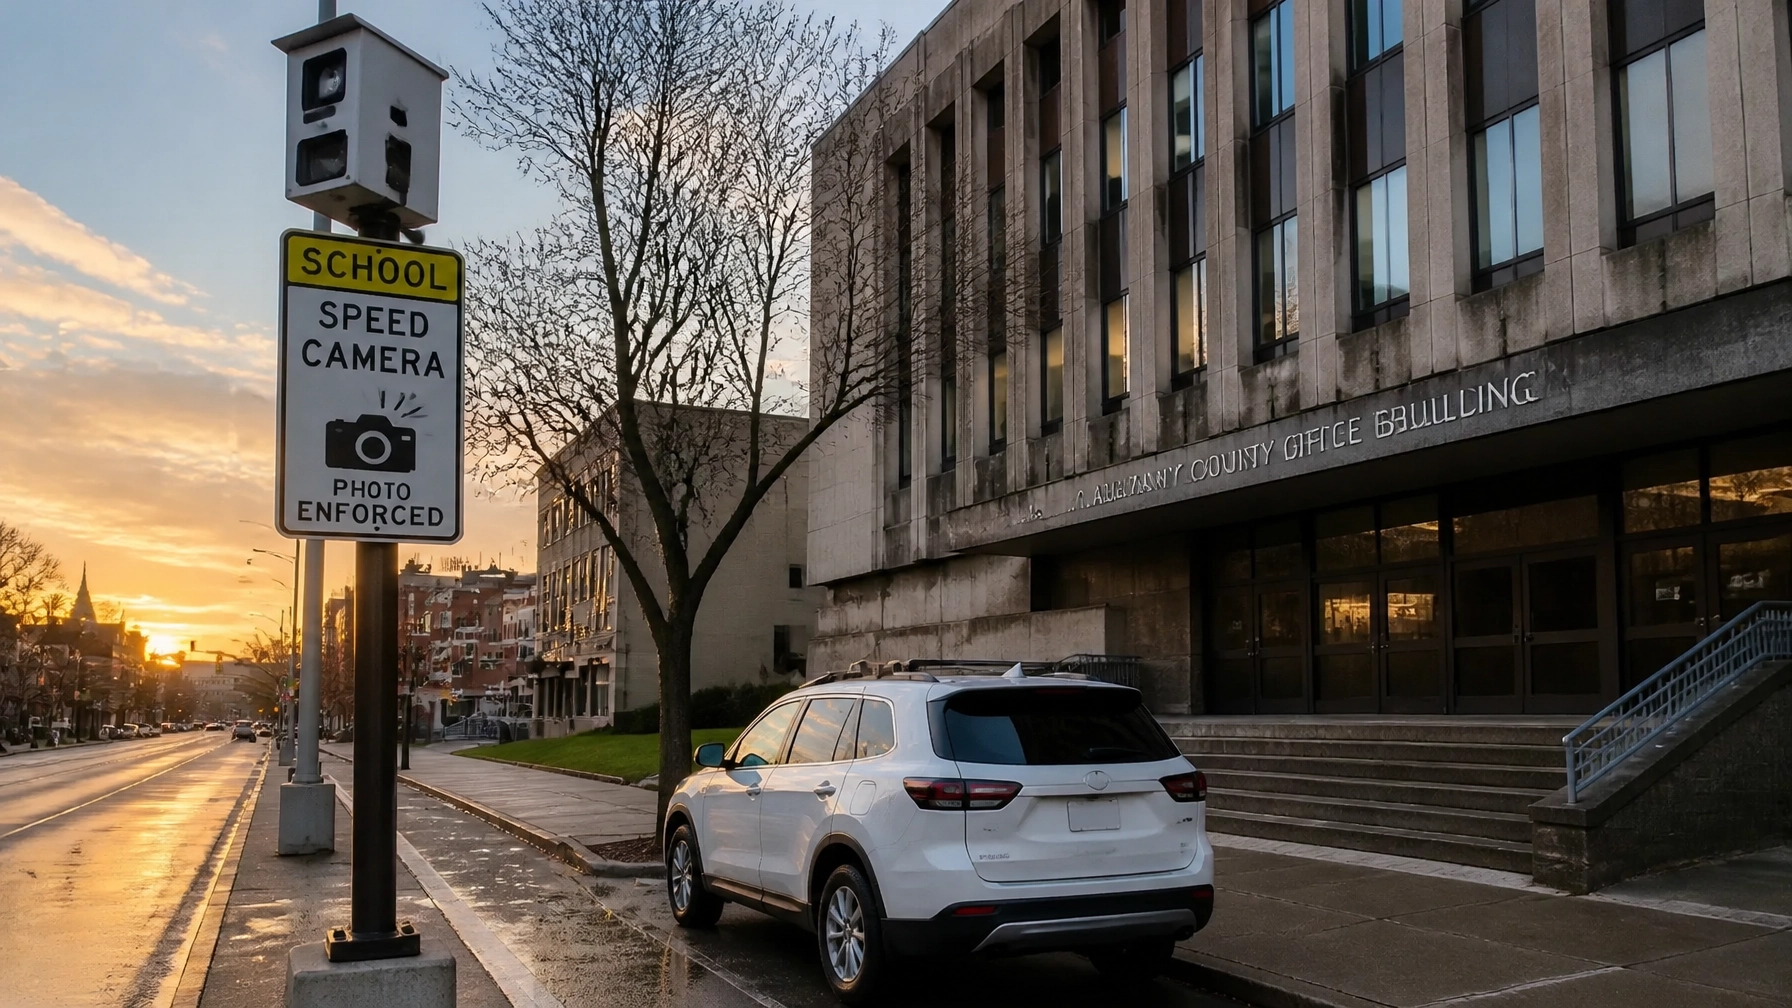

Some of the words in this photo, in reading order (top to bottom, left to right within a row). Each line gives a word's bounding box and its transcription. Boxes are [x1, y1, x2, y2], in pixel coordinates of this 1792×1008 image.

[301, 247, 447, 291] SCHOOL
[319, 301, 429, 338] SPEED
[302, 338, 445, 379] CAMERA
[333, 478, 411, 501] PHOTO
[298, 500, 444, 527] ENFORCED
